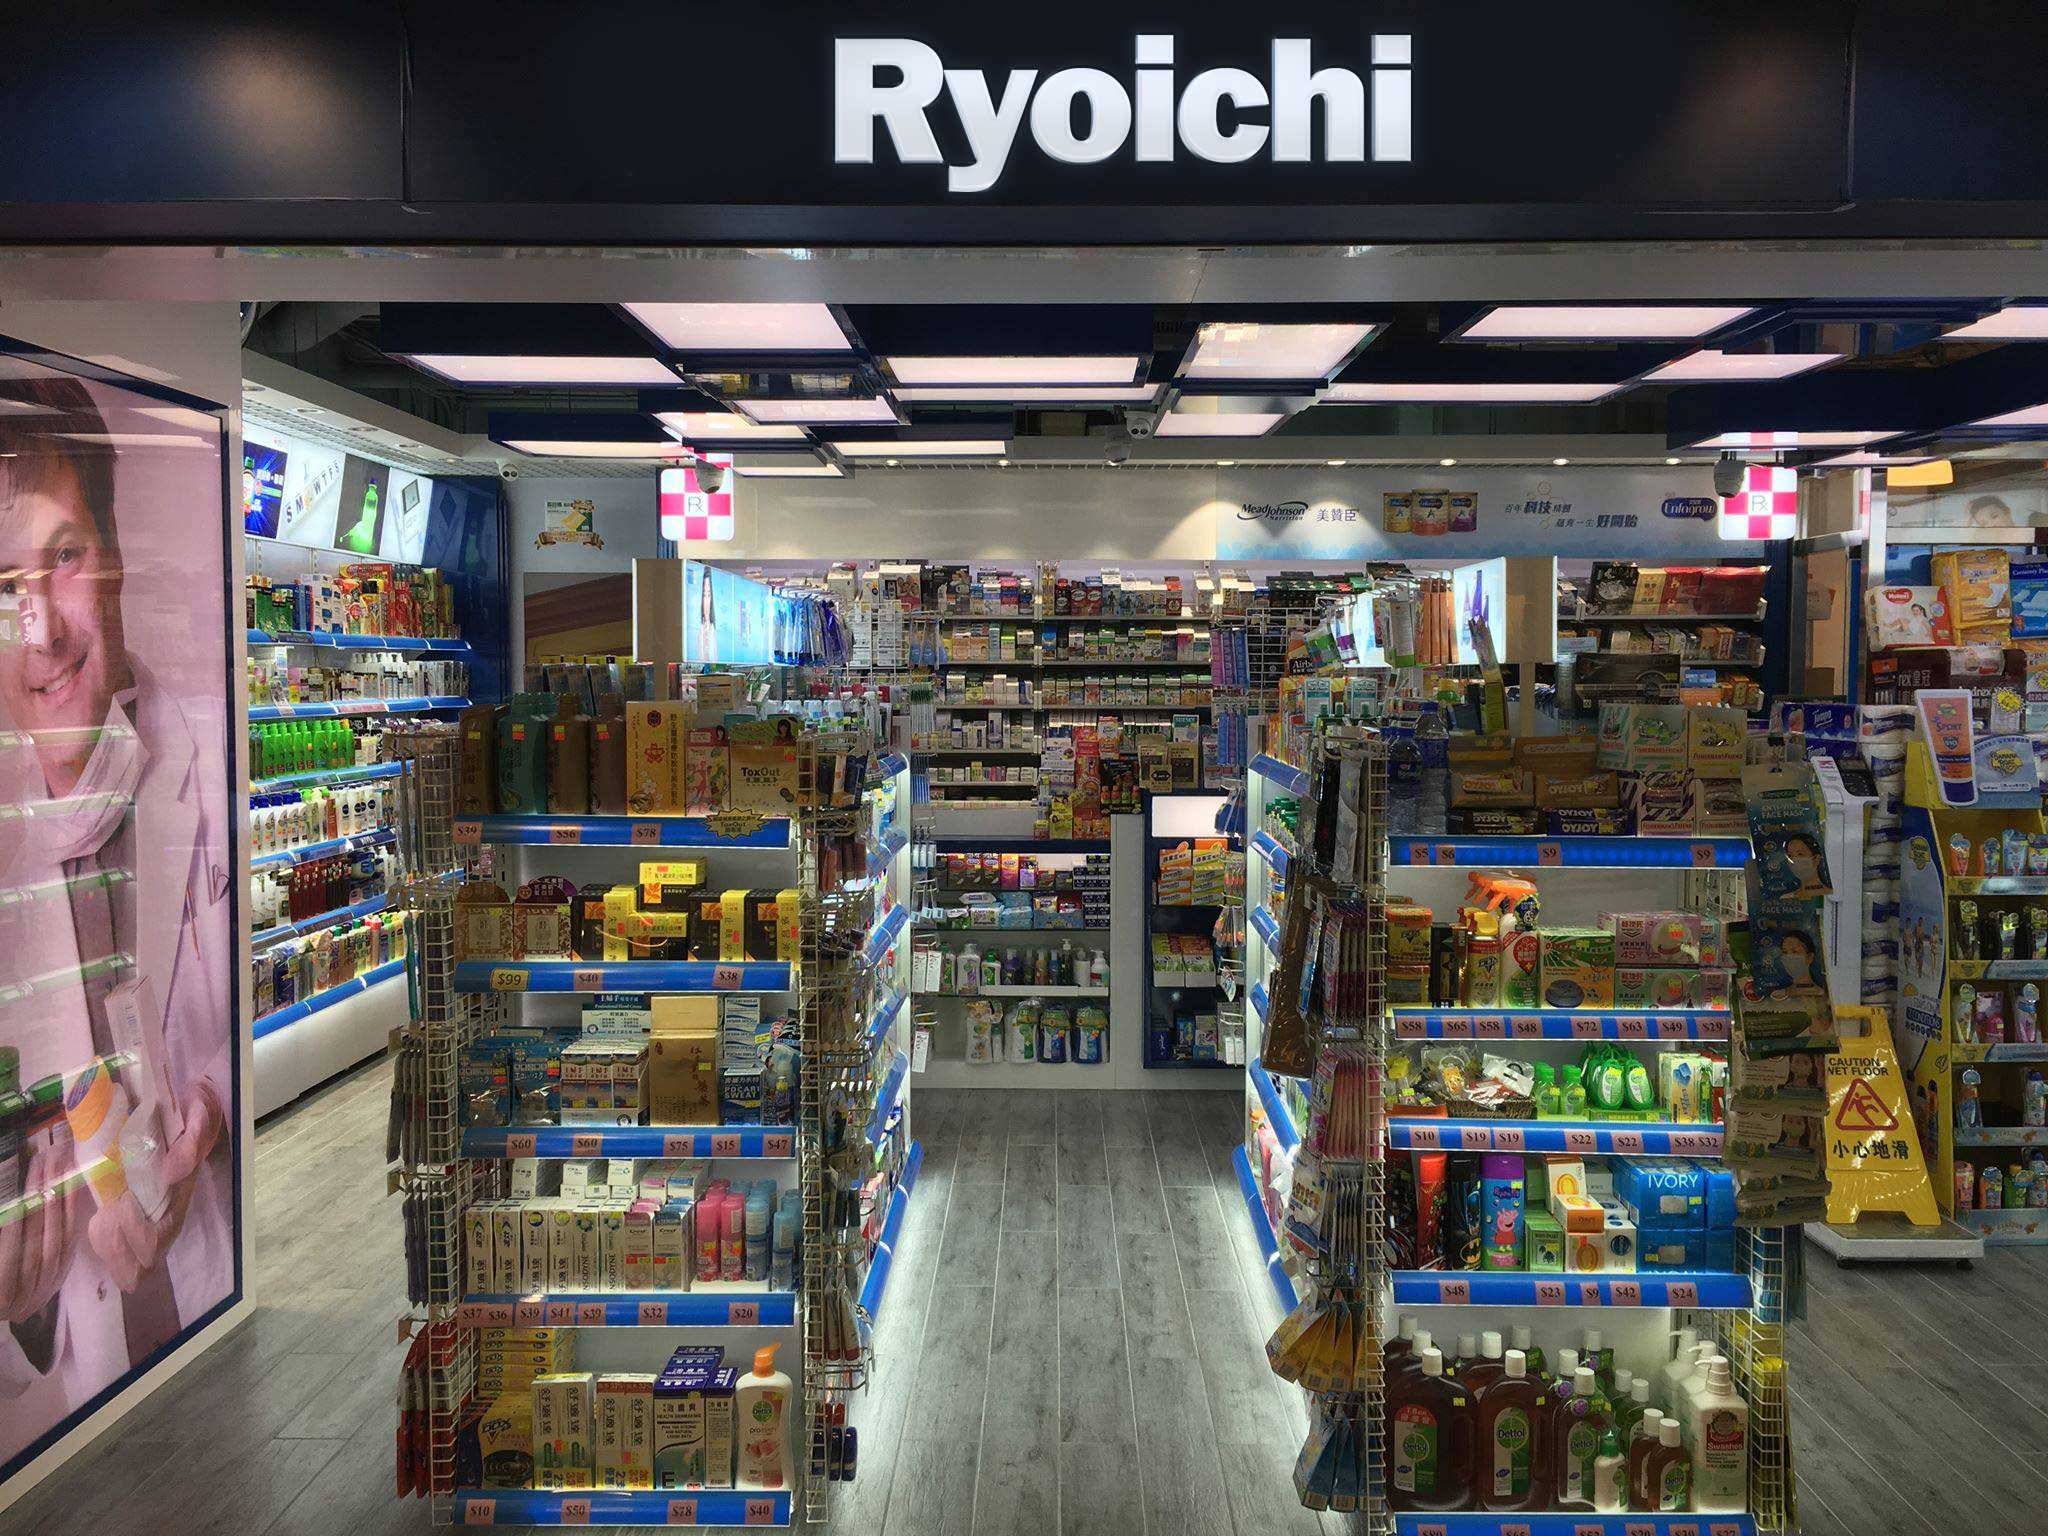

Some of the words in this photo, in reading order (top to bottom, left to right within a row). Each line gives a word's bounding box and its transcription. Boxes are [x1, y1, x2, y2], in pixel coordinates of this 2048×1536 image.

[835, 34, 1411, 192] Ryoichi
[741, 767, 780, 776] ToxOut
[457, 826, 478, 836] $39
[556, 829, 576, 839] $56
[636, 828, 656, 838] $78
[1414, 848, 1429, 859] $5
[1442, 849, 1455, 859] $6
[1542, 848, 1557, 858] $9
[1696, 849, 1711, 860] $9
[497, 974, 522, 986] $99
[719, 971, 738, 982] $38
[1402, 1021, 1422, 1031] $58
[1446, 1021, 1468, 1031] $65
[1479, 1021, 1500, 1032] $58
[1517, 1023, 1537, 1033] $48
[1576, 1022, 1598, 1032] $72
[1623, 1022, 1643, 1032] $63
[1662, 1022, 1683, 1032] $49
[1702, 1022, 1723, 1032] $29
[1829, 1057, 1880, 1067] CAUTION
[1852, 1066, 1888, 1076] FLOOR
[1414, 1131, 1435, 1142] $10
[1466, 1132, 1486, 1142] $19
[1499, 1132, 1520, 1143] $19
[1571, 1135, 1592, 1145] $22
[511, 1139, 531, 1150] $60
[578, 1138, 598, 1149] $60
[670, 1141, 689, 1152] $75
[716, 1140, 735, 1151] $15
[767, 1139, 788, 1149] $47
[1618, 1137, 1638, 1148] $22
[1674, 1137, 1695, 1148] $38
[1698, 1137, 1718, 1148] $32
[1833, 1139, 1908, 1159] 小心地滑
[1648, 1174, 1698, 1188] IVORY
[1444, 1286, 1465, 1296] $48
[1540, 1287, 1561, 1298] $23
[1586, 1287, 1600, 1298] $9
[1615, 1287, 1636, 1298] $42
[1672, 1287, 1693, 1299] $24
[462, 1308, 482, 1319] $37
[488, 1309, 507, 1321] $36
[520, 1308, 540, 1319] $39
[550, 1308, 571, 1319] $41
[583, 1308, 602, 1320] $39
[643, 1308, 663, 1319] $32
[734, 1308, 753, 1319] $20
[1498, 1428, 1525, 1438] Dettol
[1403, 1443, 1427, 1452] Dettol
[1570, 1440, 1594, 1449] Dettol
[470, 1505, 490, 1516] $10
[565, 1505, 585, 1516] $50
[749, 1504, 769, 1516] $40
